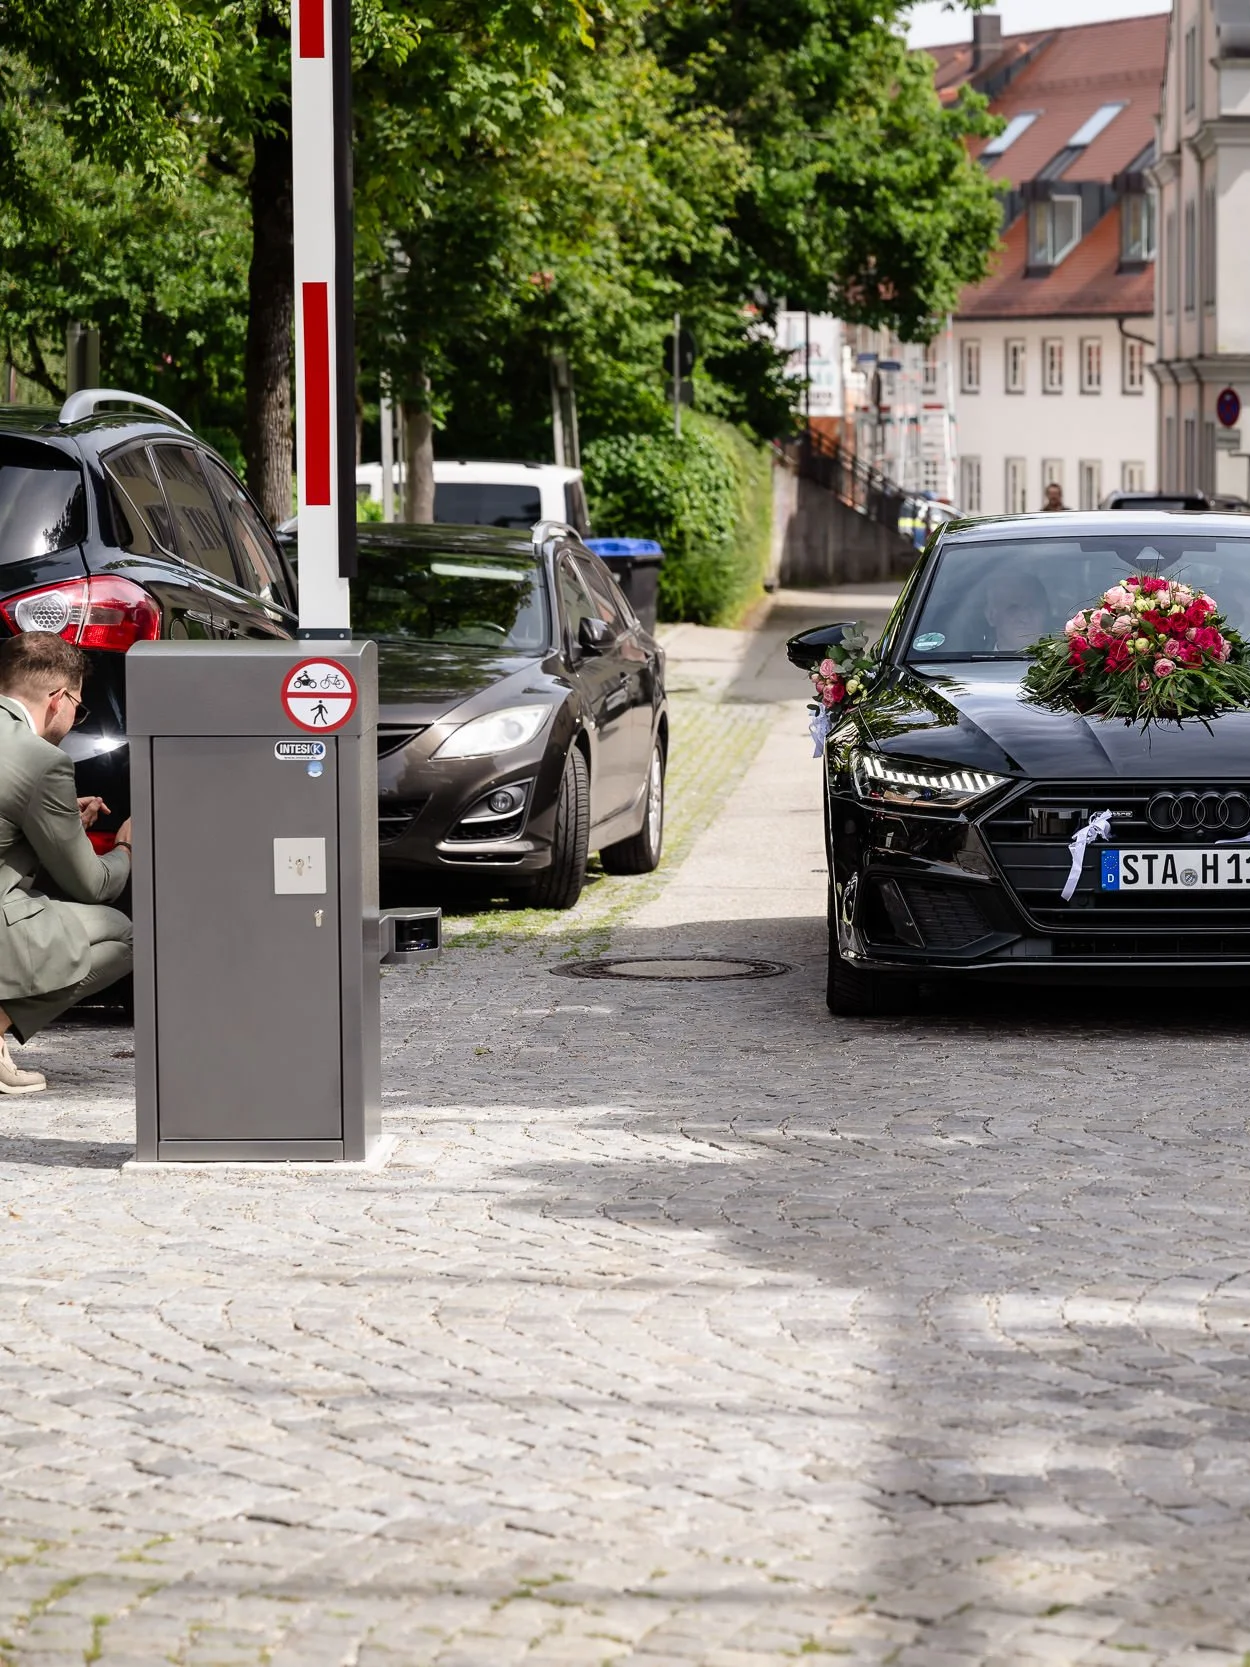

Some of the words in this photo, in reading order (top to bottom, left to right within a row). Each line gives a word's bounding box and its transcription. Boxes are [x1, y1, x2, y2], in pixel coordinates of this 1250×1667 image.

[1107, 873, 1115, 883] D
[1122, 853, 1179, 885] STA
[1201, 853, 1219, 884] H
